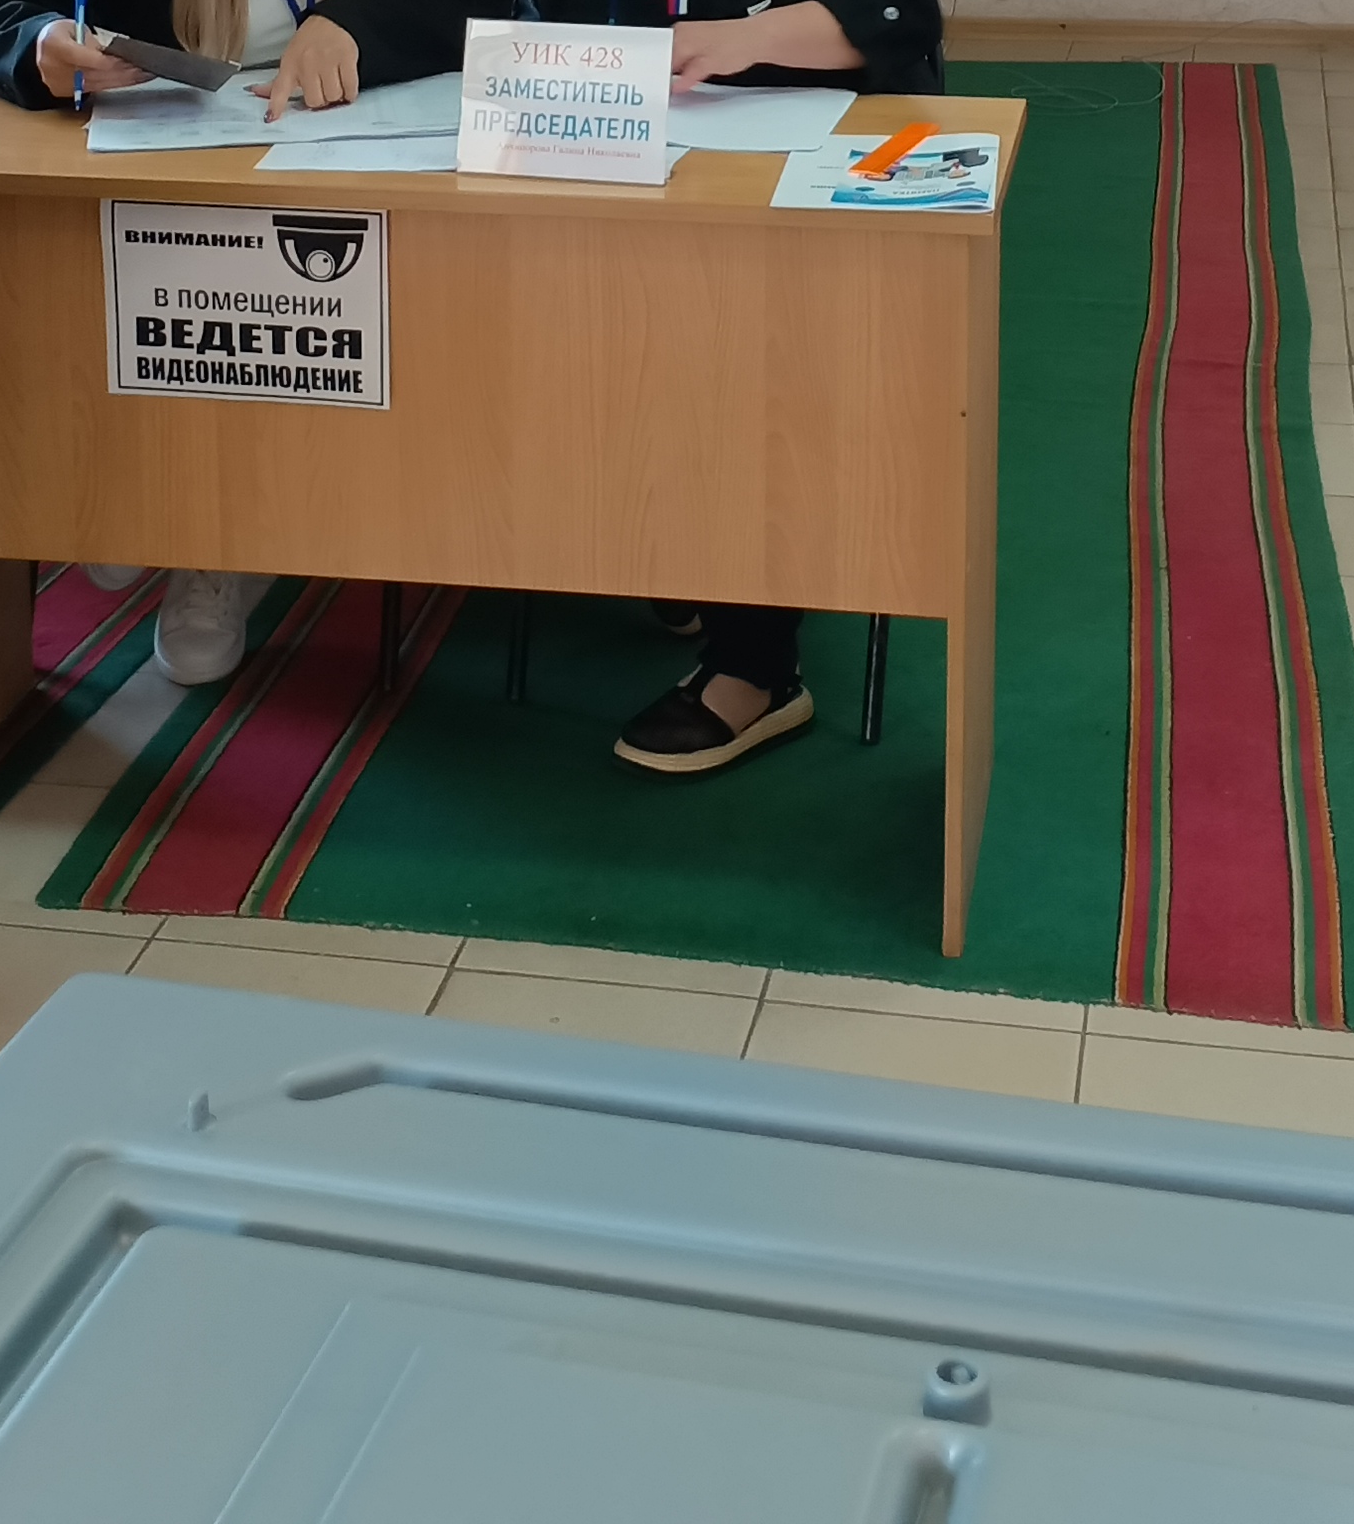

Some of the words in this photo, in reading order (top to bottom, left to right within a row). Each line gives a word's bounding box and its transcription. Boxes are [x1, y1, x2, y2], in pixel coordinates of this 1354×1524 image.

[512, 42, 572, 66] УИК
[580, 46, 624, 69] 428
[485, 77, 644, 106] ЗАМЕСТИТЕЛЬ
[473, 109, 650, 141] ПРЕДСЕДАТЕЛЯ
[124, 230, 264, 249] ВНИМАНИЕ!
[178, 288, 343, 318] помещении
[135, 316, 363, 360] ВЕДЕТСЯ
[136, 356, 364, 393] ВИДЕОНАБЛЮДЕНИЕ
